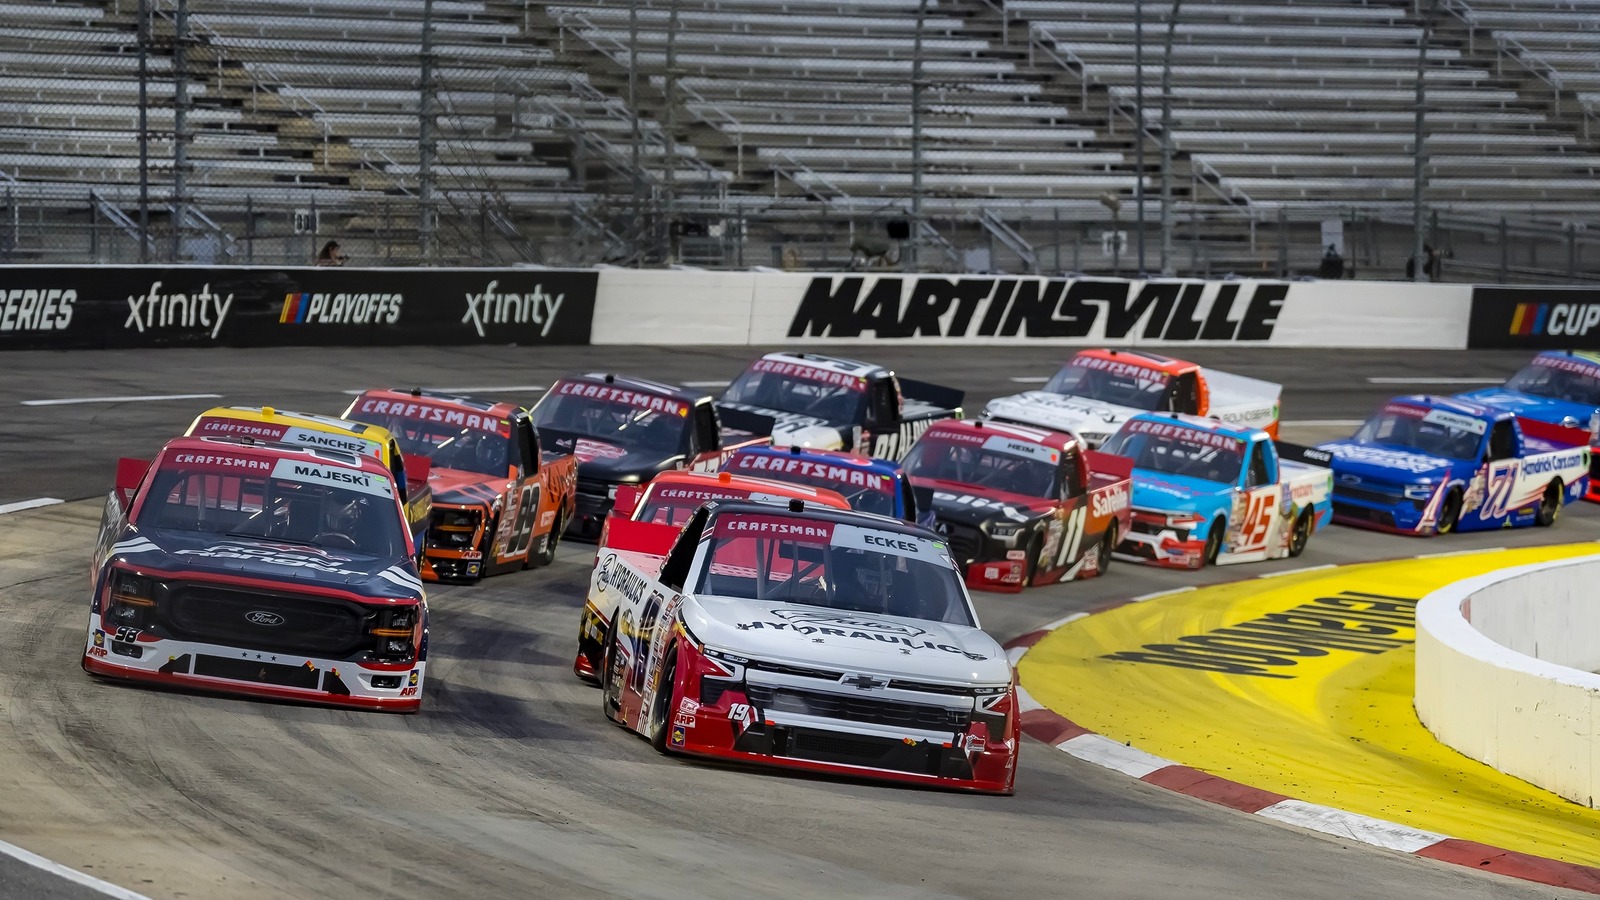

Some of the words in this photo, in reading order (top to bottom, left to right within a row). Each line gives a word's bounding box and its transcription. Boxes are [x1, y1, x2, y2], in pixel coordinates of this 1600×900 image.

[124, 281, 234, 338] xfinity
[305, 293, 403, 323] PLAYOFFS
[461, 280, 564, 336] xfinity
[787, 277, 1290, 340] MARTINSVILLE
[1547, 304, 1600, 336] CUP
[752, 360, 854, 388] CRAFTSMAN
[1072, 356, 1162, 382] CRAFTSMAN
[560, 382, 679, 415] CRAFTSMAN
[360, 399, 499, 432] CRAFTSMAN
[204, 422, 281, 438] CRAFTSMAN
[297, 433, 366, 453] SANCHEZ
[929, 430, 985, 444] CRAFTSMAN
[1007, 442, 1035, 454] HEIM
[1127, 420, 1238, 451] CRAFTSMAN
[175, 453, 270, 471] CRAFTSMAN
[294, 465, 370, 487] MAJESKI
[739, 455, 882, 490] CRAFTSMAN
[1480, 463, 1519, 520] 71
[504, 482, 541, 558] 99
[1241, 491, 1276, 547] 45
[727, 520, 828, 539] CRAFTSMAN
[863, 534, 919, 553] ECKES
[1056, 506, 1088, 567] 11
[609, 562, 647, 605] HYDRAULICS
[115, 626, 143, 643] 98
[251, 612, 279, 625] Ford
[88, 646, 107, 658] ARP
[400, 687, 418, 696] ARP
[674, 713, 695, 725] ARP
[727, 702, 751, 721] 19
